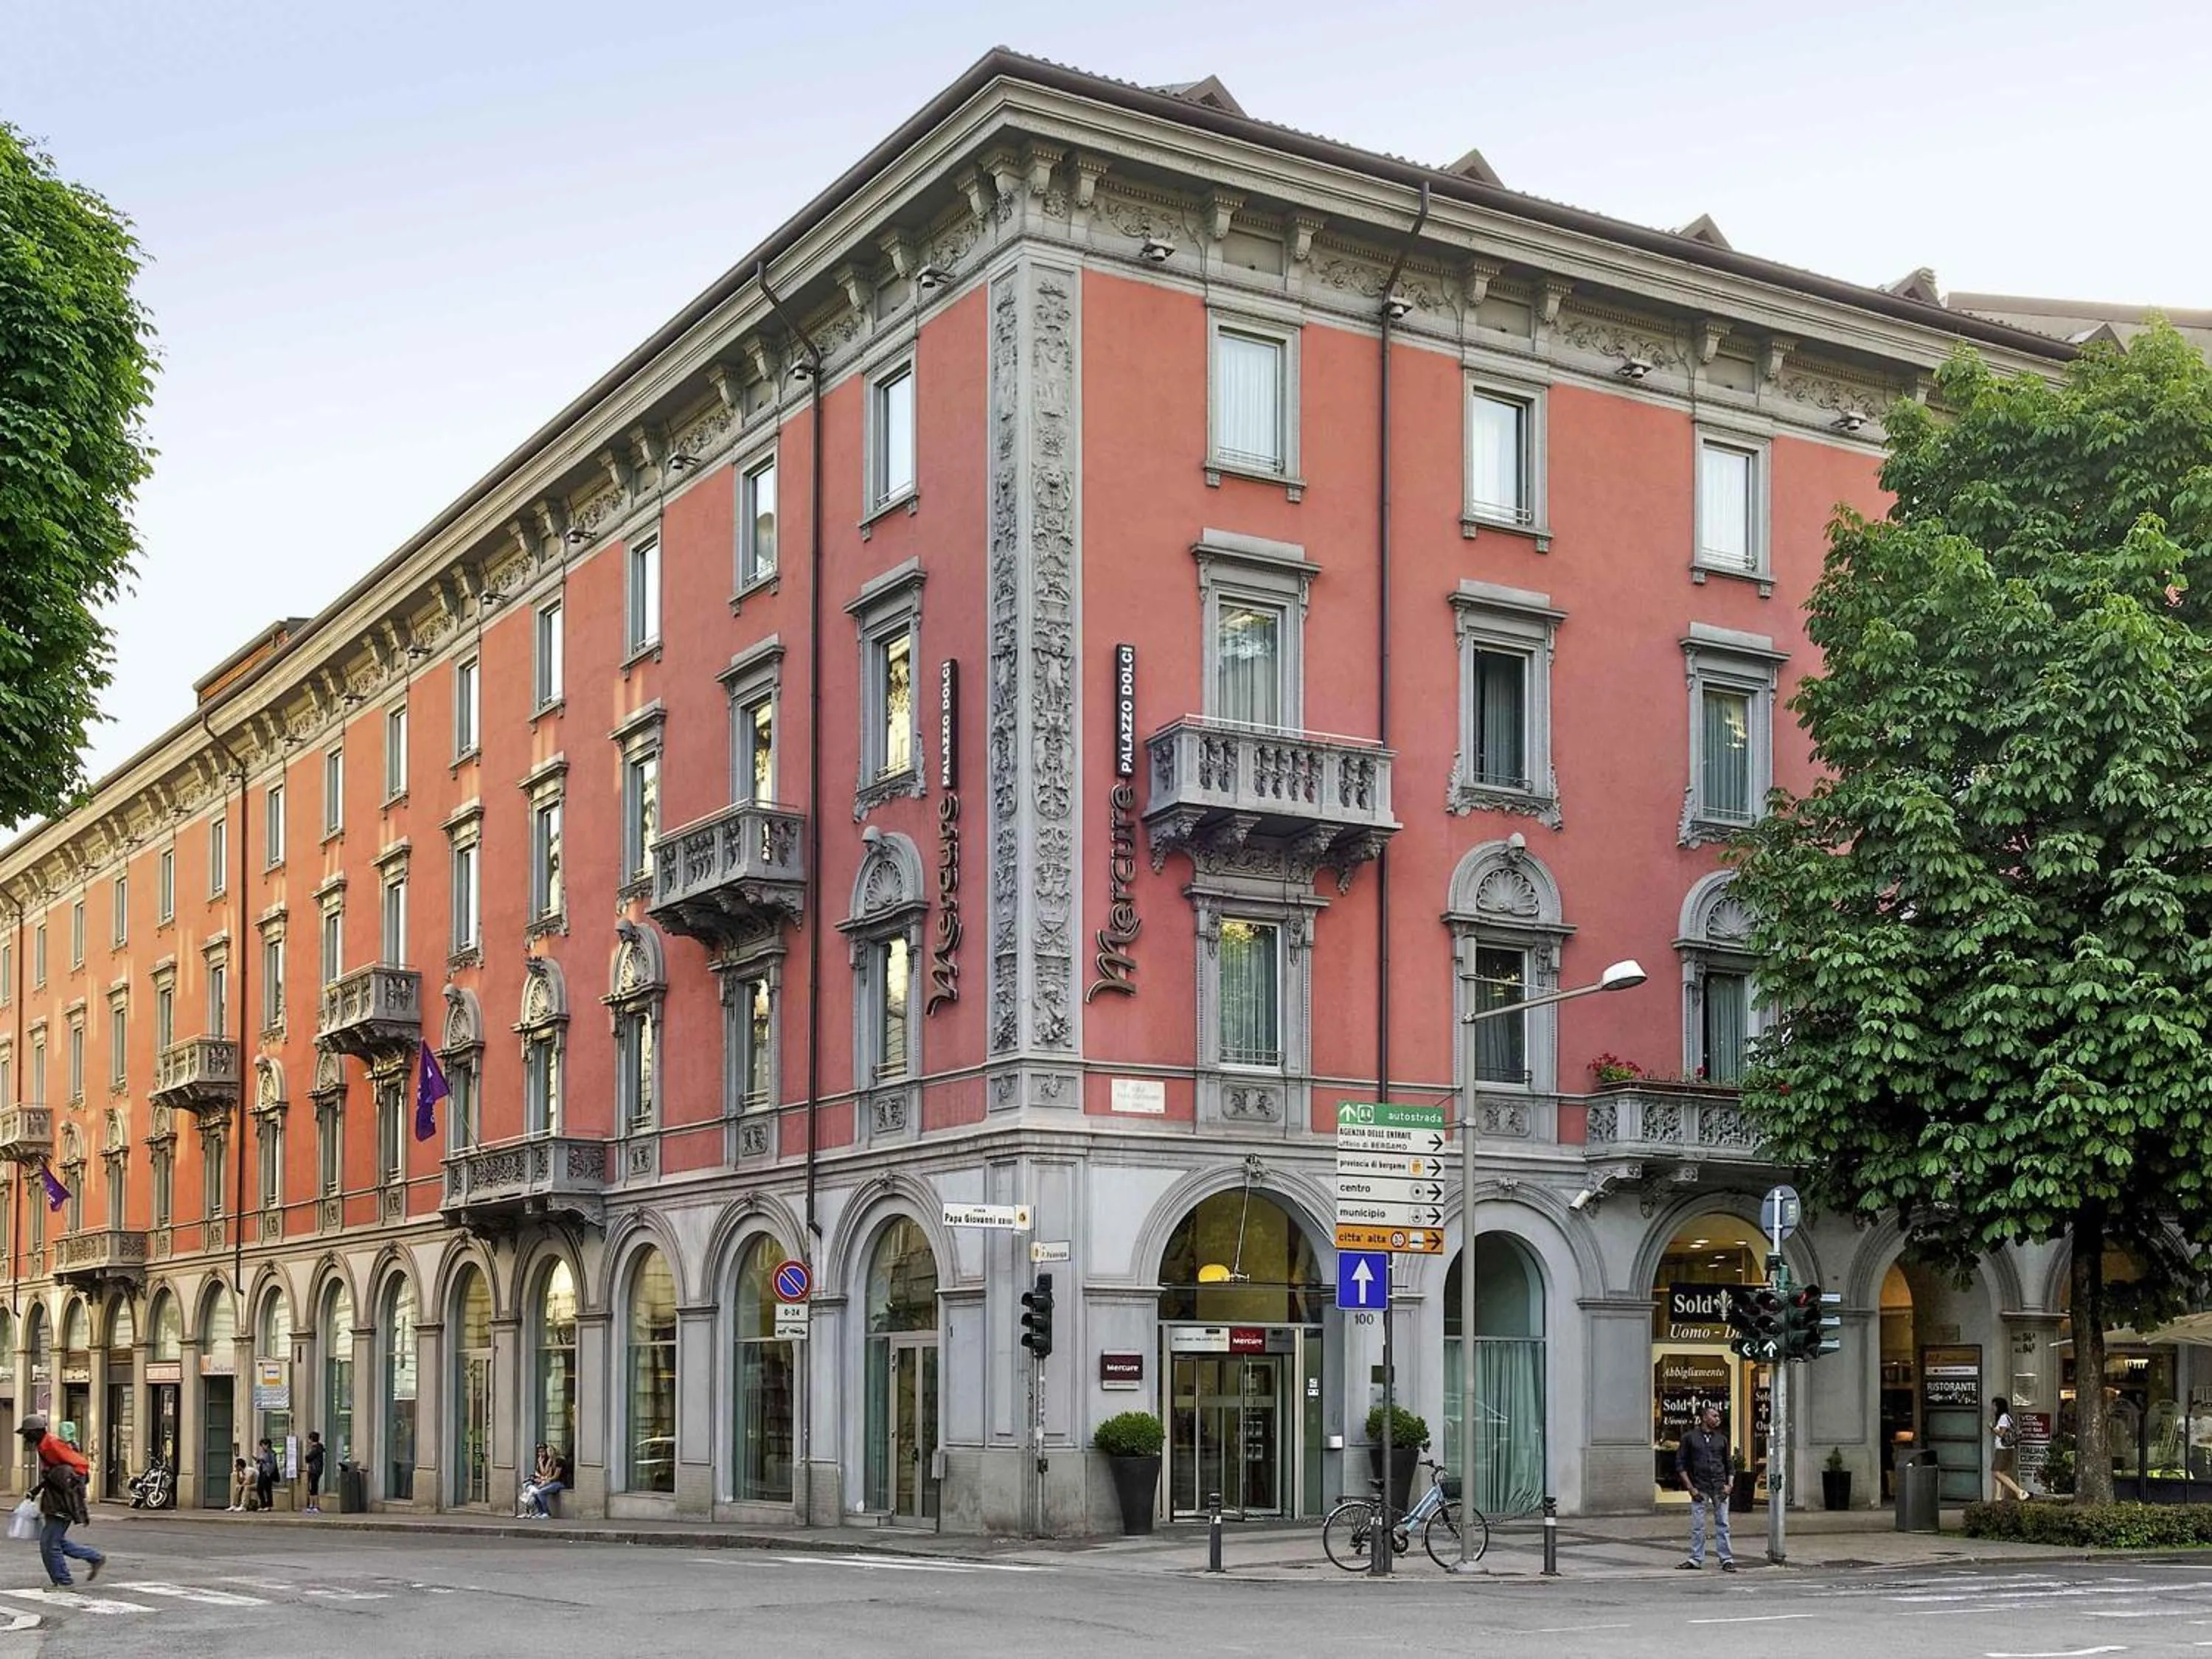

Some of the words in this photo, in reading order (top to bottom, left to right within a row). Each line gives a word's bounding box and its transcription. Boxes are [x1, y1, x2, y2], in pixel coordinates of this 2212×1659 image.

[1121, 647, 1134, 699] DOLCI
[942, 661, 951, 709] DOLCI
[1121, 703, 1134, 773] PALAZZO
[942, 714, 951, 786] PALAZZO
[1085, 784, 1141, 1004] Mercure
[926, 793, 962, 1017] Mercure
[1388, 1112, 1443, 1123] autostrada
[1339, 1128, 1366, 1137] AGENZIA
[1366, 1129, 1385, 1138] DELLE
[1386, 1130, 1412, 1140] ENTRATE
[1371, 1141, 1408, 1150] BERGAMO
[1339, 1159, 1369, 1169] provincia
[1371, 1160, 1377, 1169] di
[1378, 1161, 1406, 1171] bergamo
[1339, 1183, 1371, 1193] centro
[945, 1213, 962, 1224] Papa
[964, 1214, 996, 1225] Giovanni
[1339, 1208, 1386, 1219] municipio
[1368, 1234, 1386, 1243] alta
[1674, 1293, 1713, 1314] Sold
[1354, 1313, 1374, 1325] 100
[1670, 1324, 1711, 1339] Uomo
[1232, 1337, 1263, 1346] Mercure
[1106, 1363, 1139, 1372] Mercure
[1663, 1366, 1725, 1380] Abbigliamento
[1926, 1381, 1977, 1391] RISTORANTE
[1663, 1399, 1687, 1412] Sold
